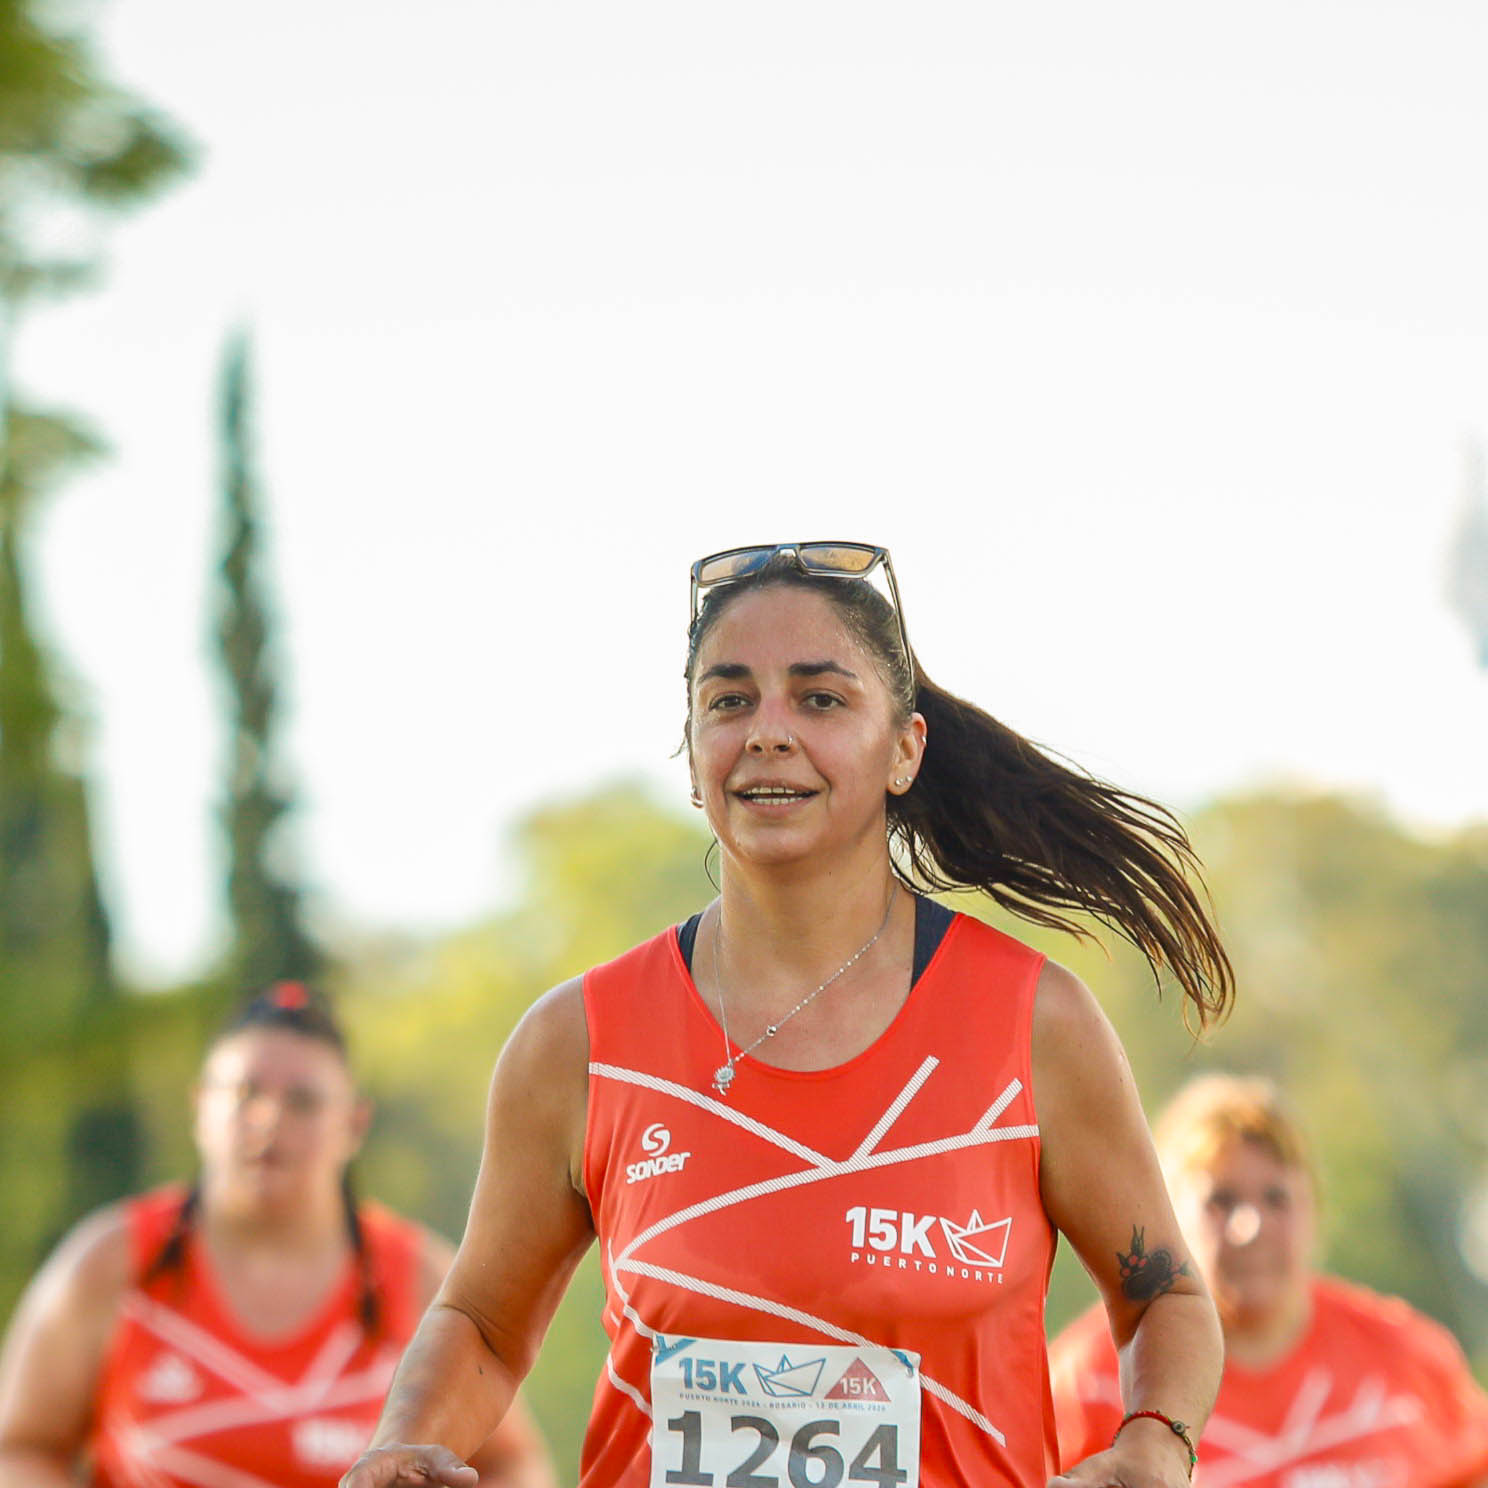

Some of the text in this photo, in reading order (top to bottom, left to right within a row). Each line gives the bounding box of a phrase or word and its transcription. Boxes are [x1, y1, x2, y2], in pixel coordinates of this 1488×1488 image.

[845, 1205, 937, 1258] 15K
[850, 1252, 1003, 1284] PUERTO NORTE
[678, 1357, 748, 1395] 15K
[839, 1376, 877, 1396] 15K
